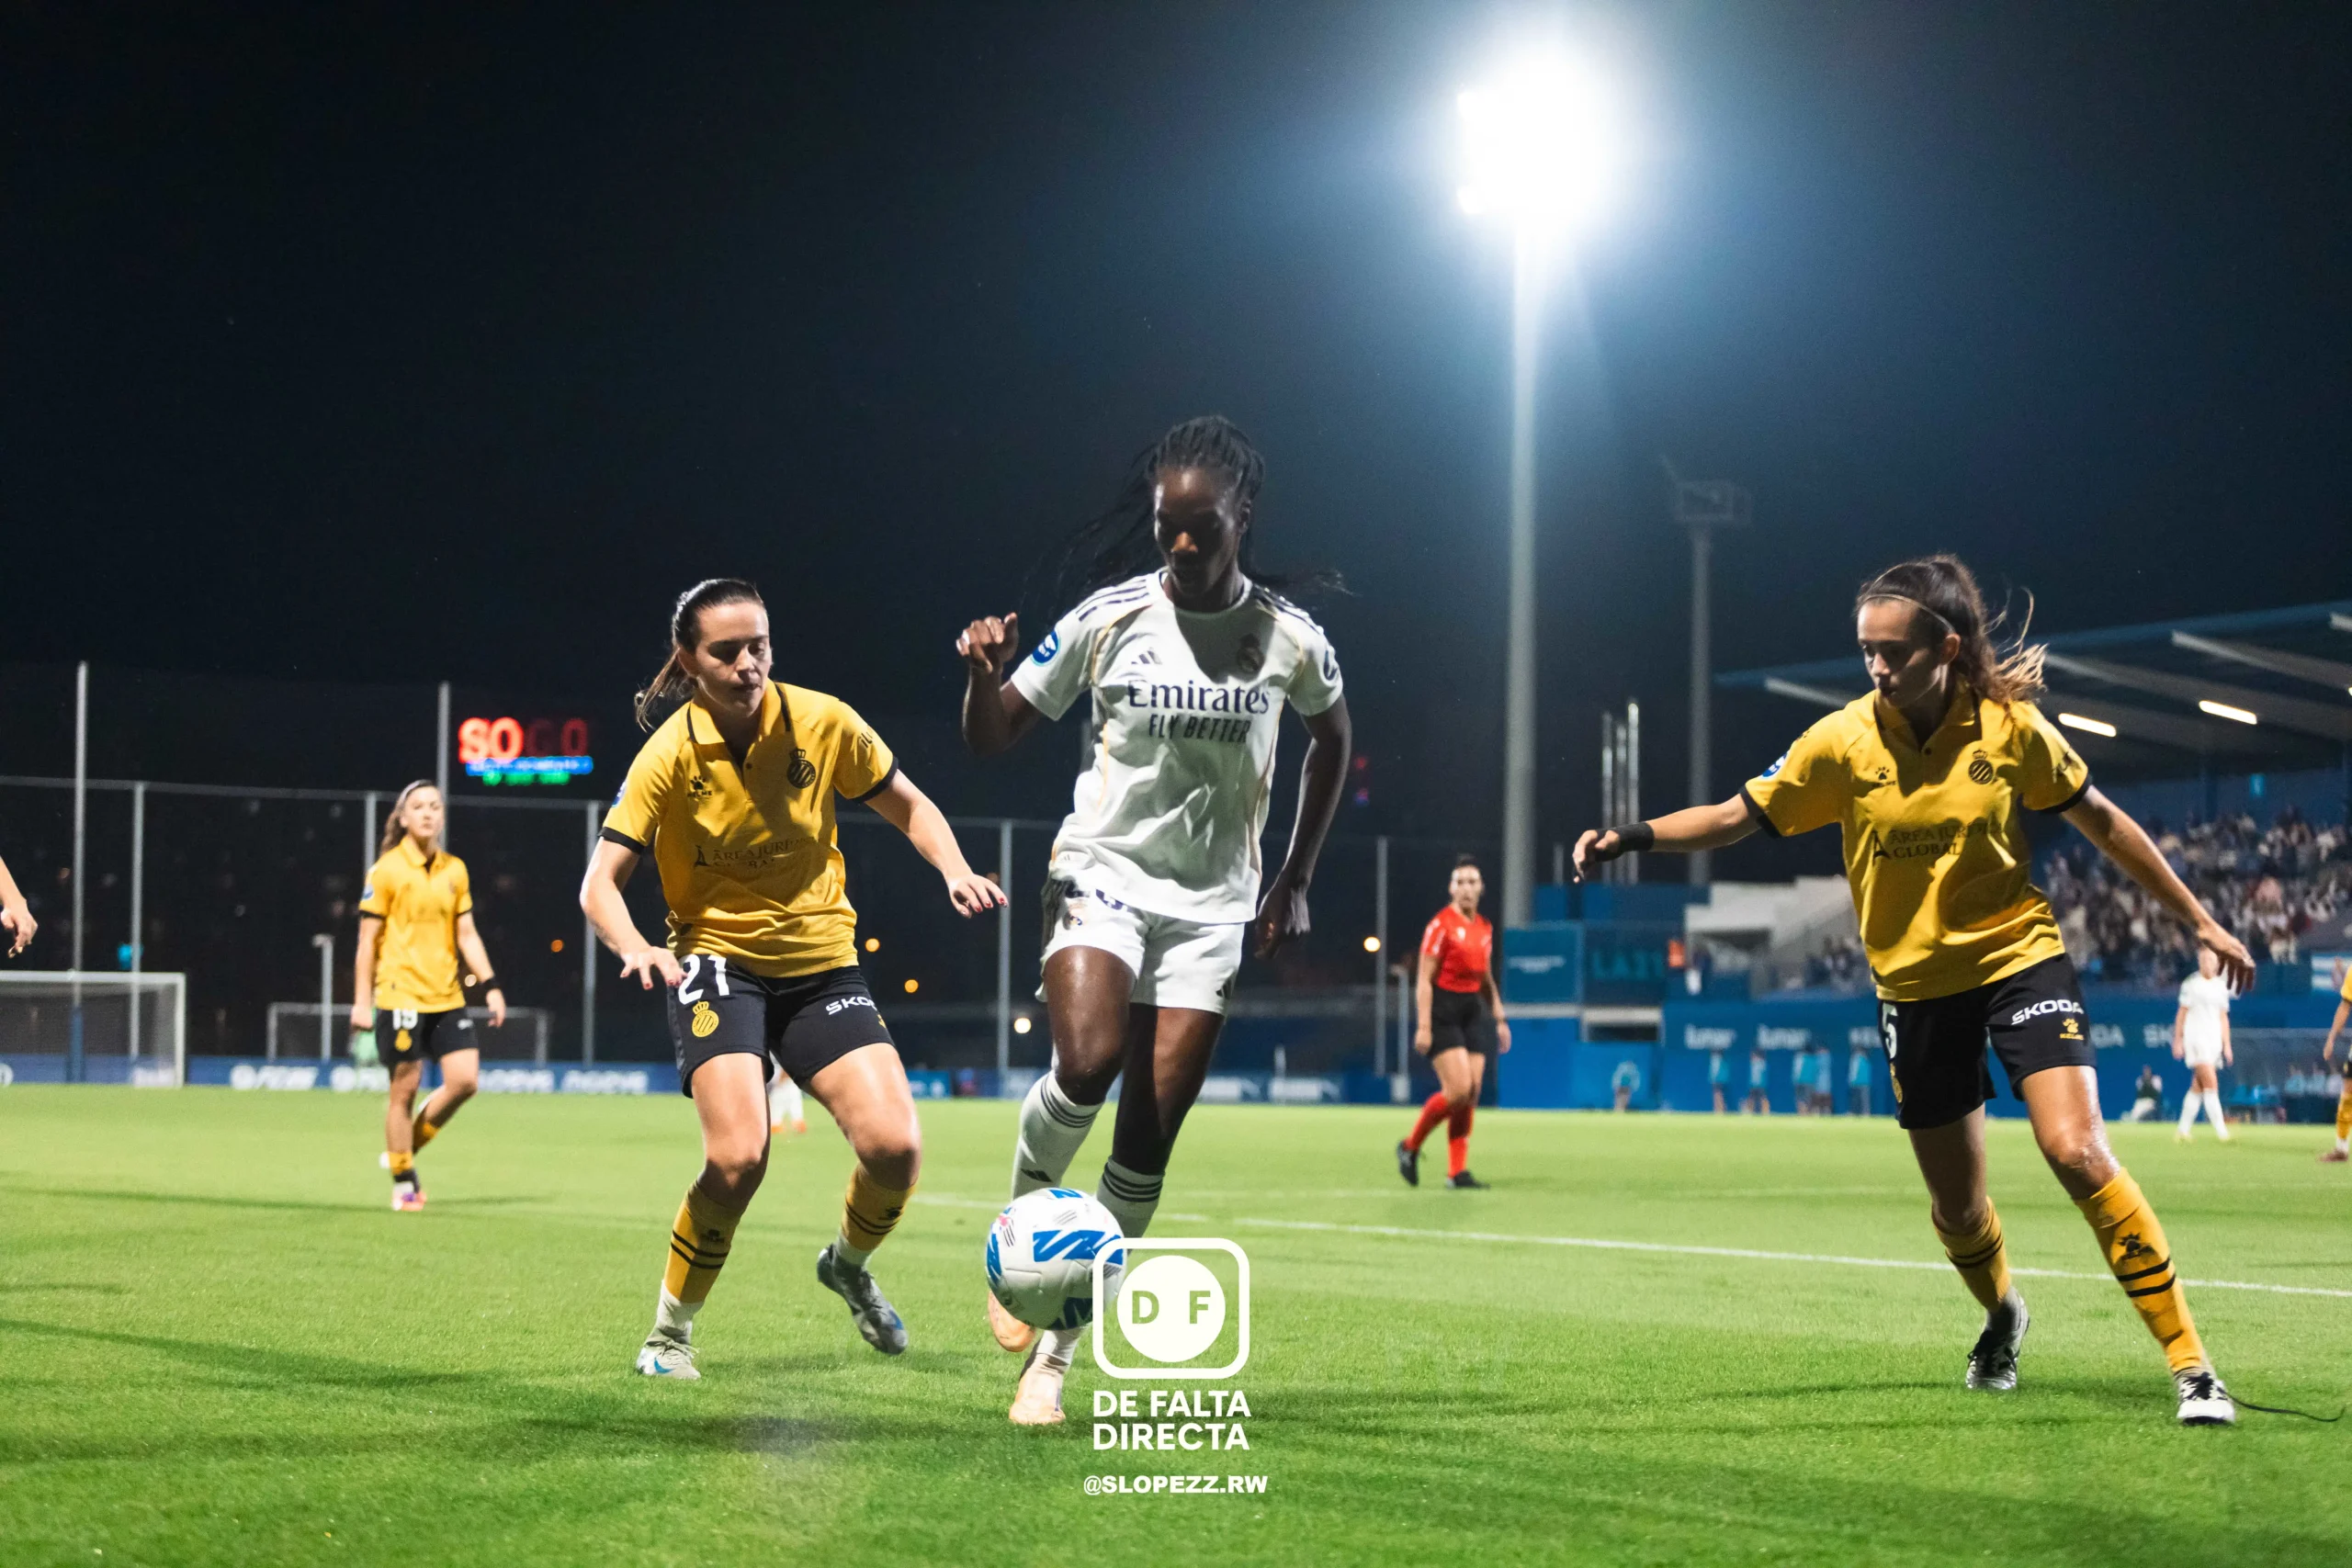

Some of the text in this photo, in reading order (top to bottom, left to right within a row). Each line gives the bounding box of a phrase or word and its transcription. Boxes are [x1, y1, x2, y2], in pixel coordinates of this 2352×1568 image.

[1128, 680, 1270, 714] Emirates
[1149, 713, 1251, 743] FLY BETTER
[678, 954, 730, 1006] 21
[2011, 998, 2084, 1025] SKODA
